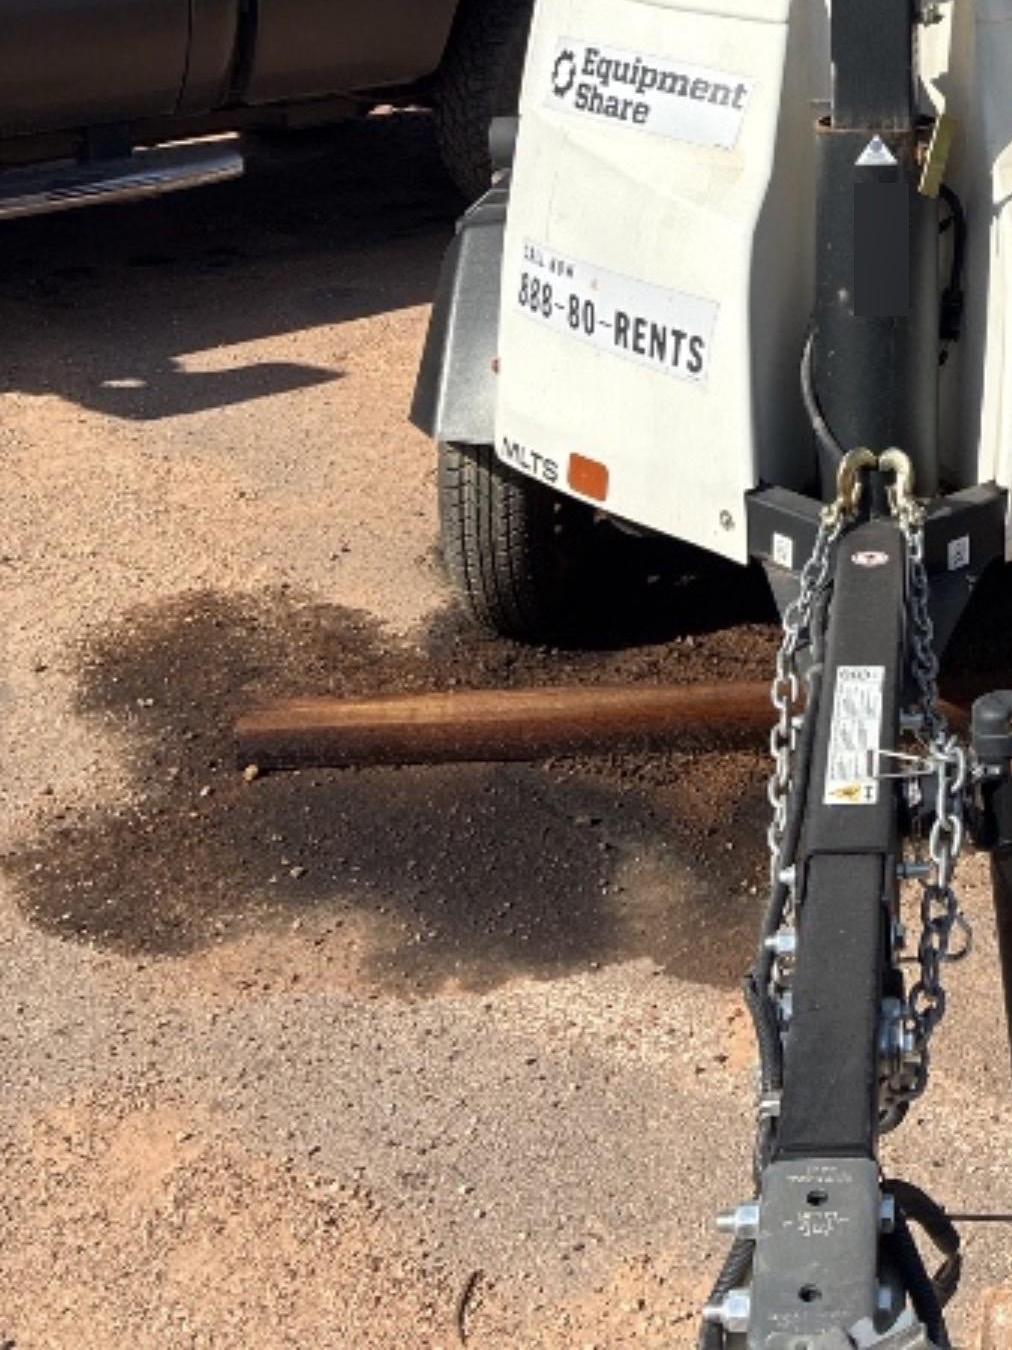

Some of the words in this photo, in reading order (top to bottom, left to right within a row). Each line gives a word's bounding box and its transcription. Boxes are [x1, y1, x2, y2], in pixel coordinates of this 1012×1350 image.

[574, 82, 651, 125] Share
[581, 46, 747, 110] Equipment
[517, 271, 705, 374] 888-80-RENTS
[500, 435, 559, 484] MLTS
